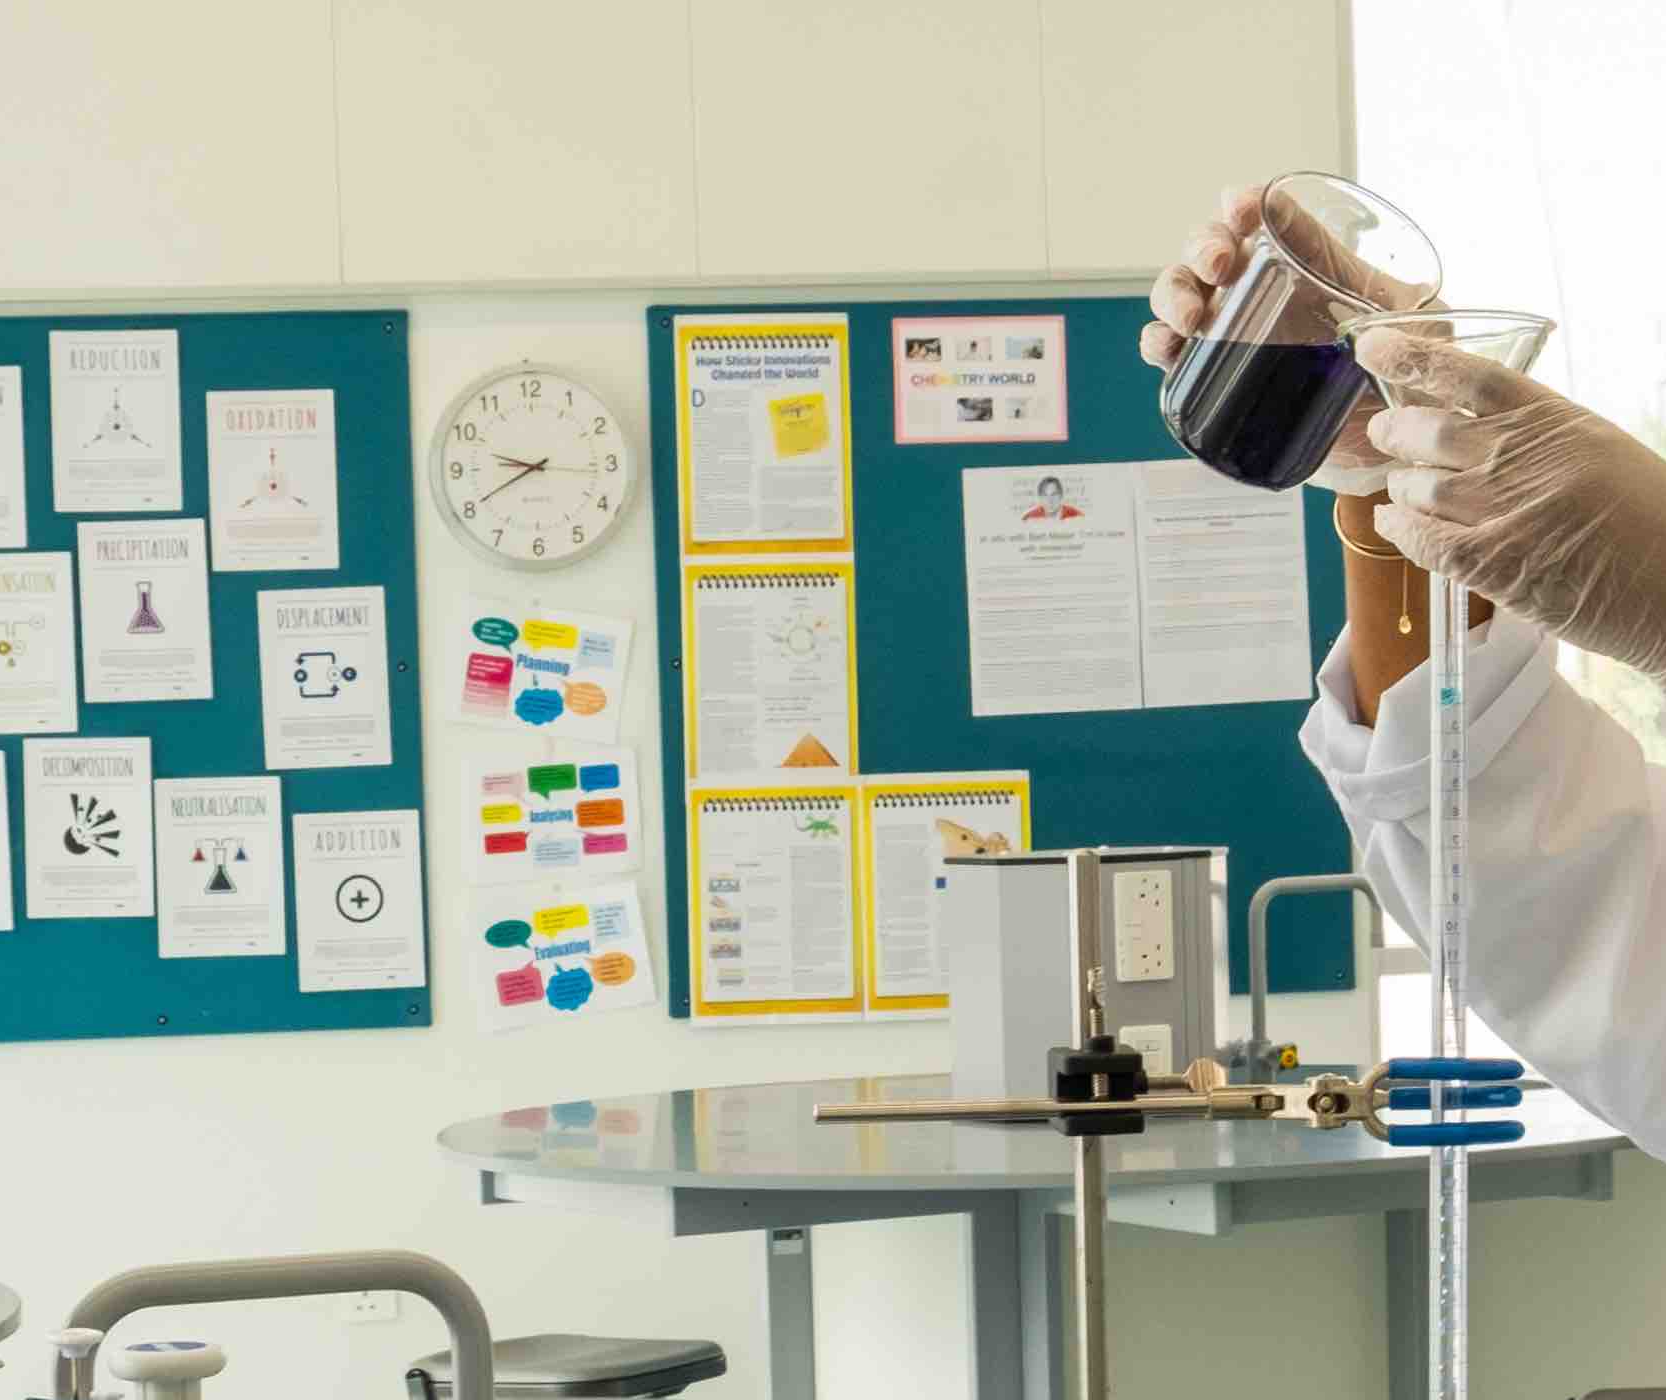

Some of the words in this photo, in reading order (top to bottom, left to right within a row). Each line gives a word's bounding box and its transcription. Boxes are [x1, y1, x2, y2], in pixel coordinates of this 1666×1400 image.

[70, 349, 161, 371] REDUCTION
[988, 373, 1036, 385] WORLD
[521, 381, 541, 397] 12
[481, 396, 499, 411] 11
[226, 408, 317, 430] OXIDATION
[594, 417, 606, 434] 2
[453, 424, 476, 441] 10
[450, 463, 463, 479] 9
[605, 456, 618, 472] 3
[464, 502, 476, 518] 8
[597, 496, 608, 511] 4
[492, 531, 504, 547] 7
[572, 527, 584, 543] 5
[96, 539, 190, 561] PRECIPITATION
[533, 539, 544, 556] 6
[276, 606, 370, 629] DISPLACEMENT
[42, 756, 134, 778] DECOMPOSITION
[170, 796, 266, 817] NEUTRALISATION
[315, 830, 402, 852] ADDITION
